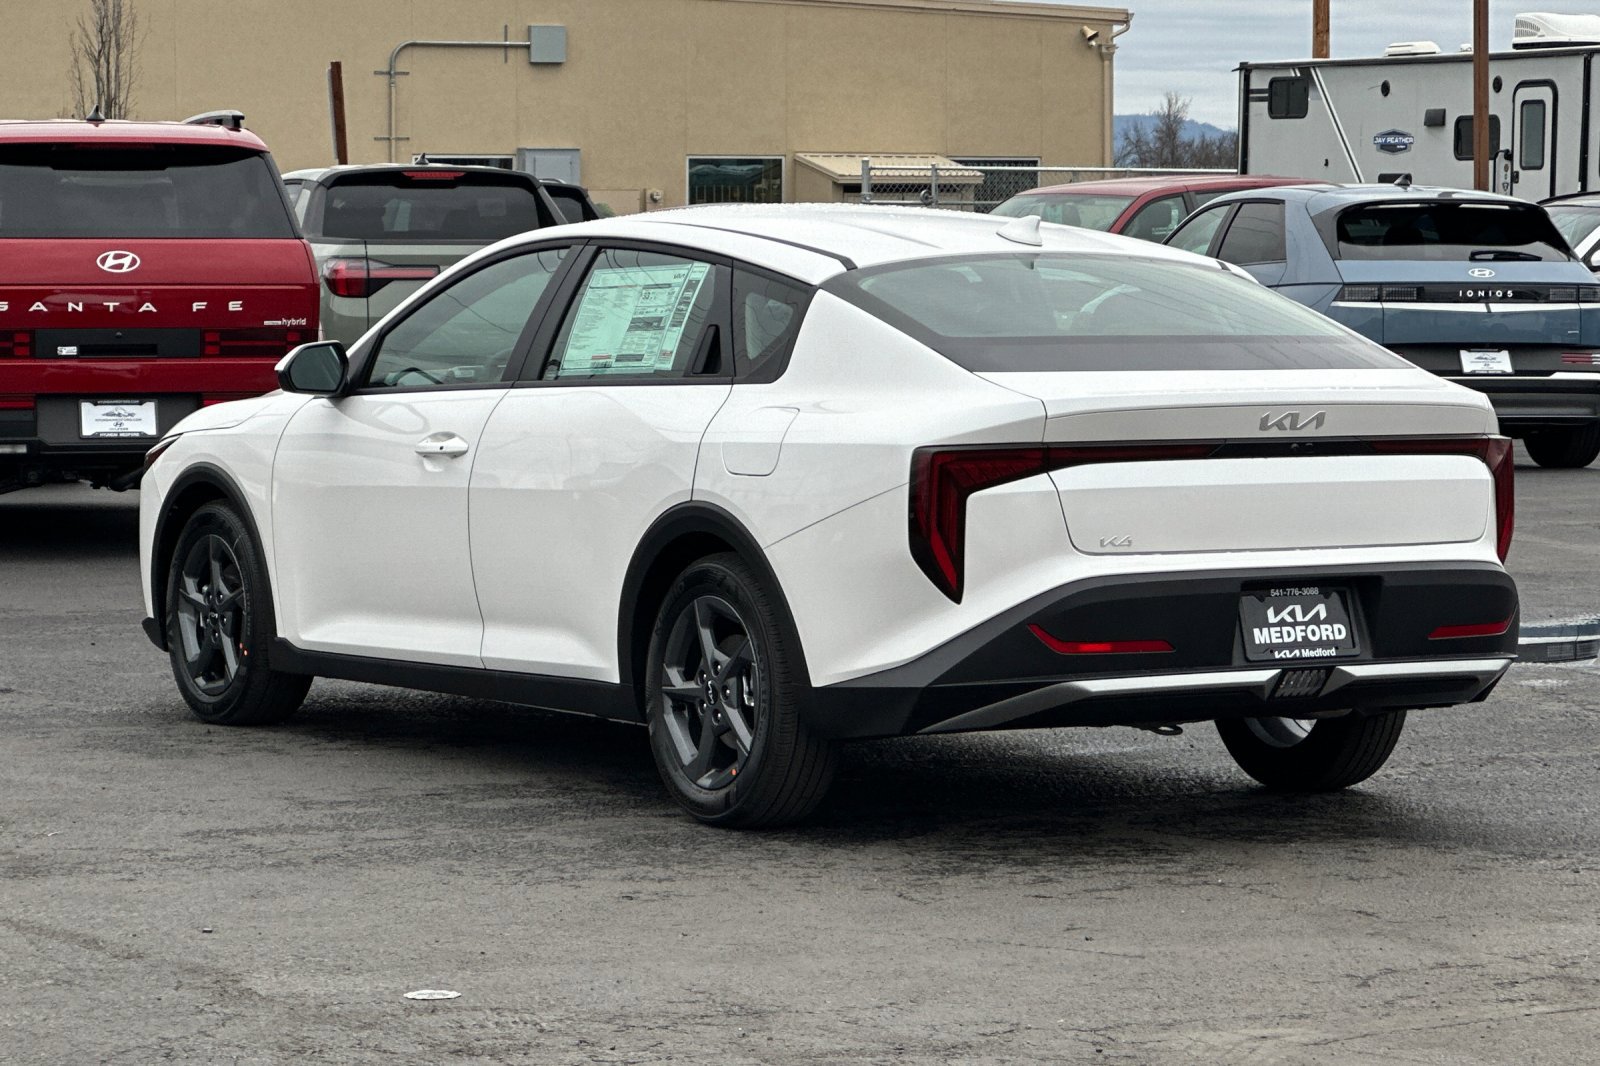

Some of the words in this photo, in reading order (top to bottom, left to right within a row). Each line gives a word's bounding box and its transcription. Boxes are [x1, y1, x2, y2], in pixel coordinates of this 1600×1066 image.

[192, 300, 243, 312] FE
[282, 317, 307, 327] hybrid
[1258, 410, 1327, 432] KIA
[1099, 534, 1133, 548] K4
[1267, 603, 1327, 624] KIA
[1253, 624, 1346, 644] MEDFORD
[1274, 648, 1300, 659] KIA
[1301, 647, 1337, 658] Medford
